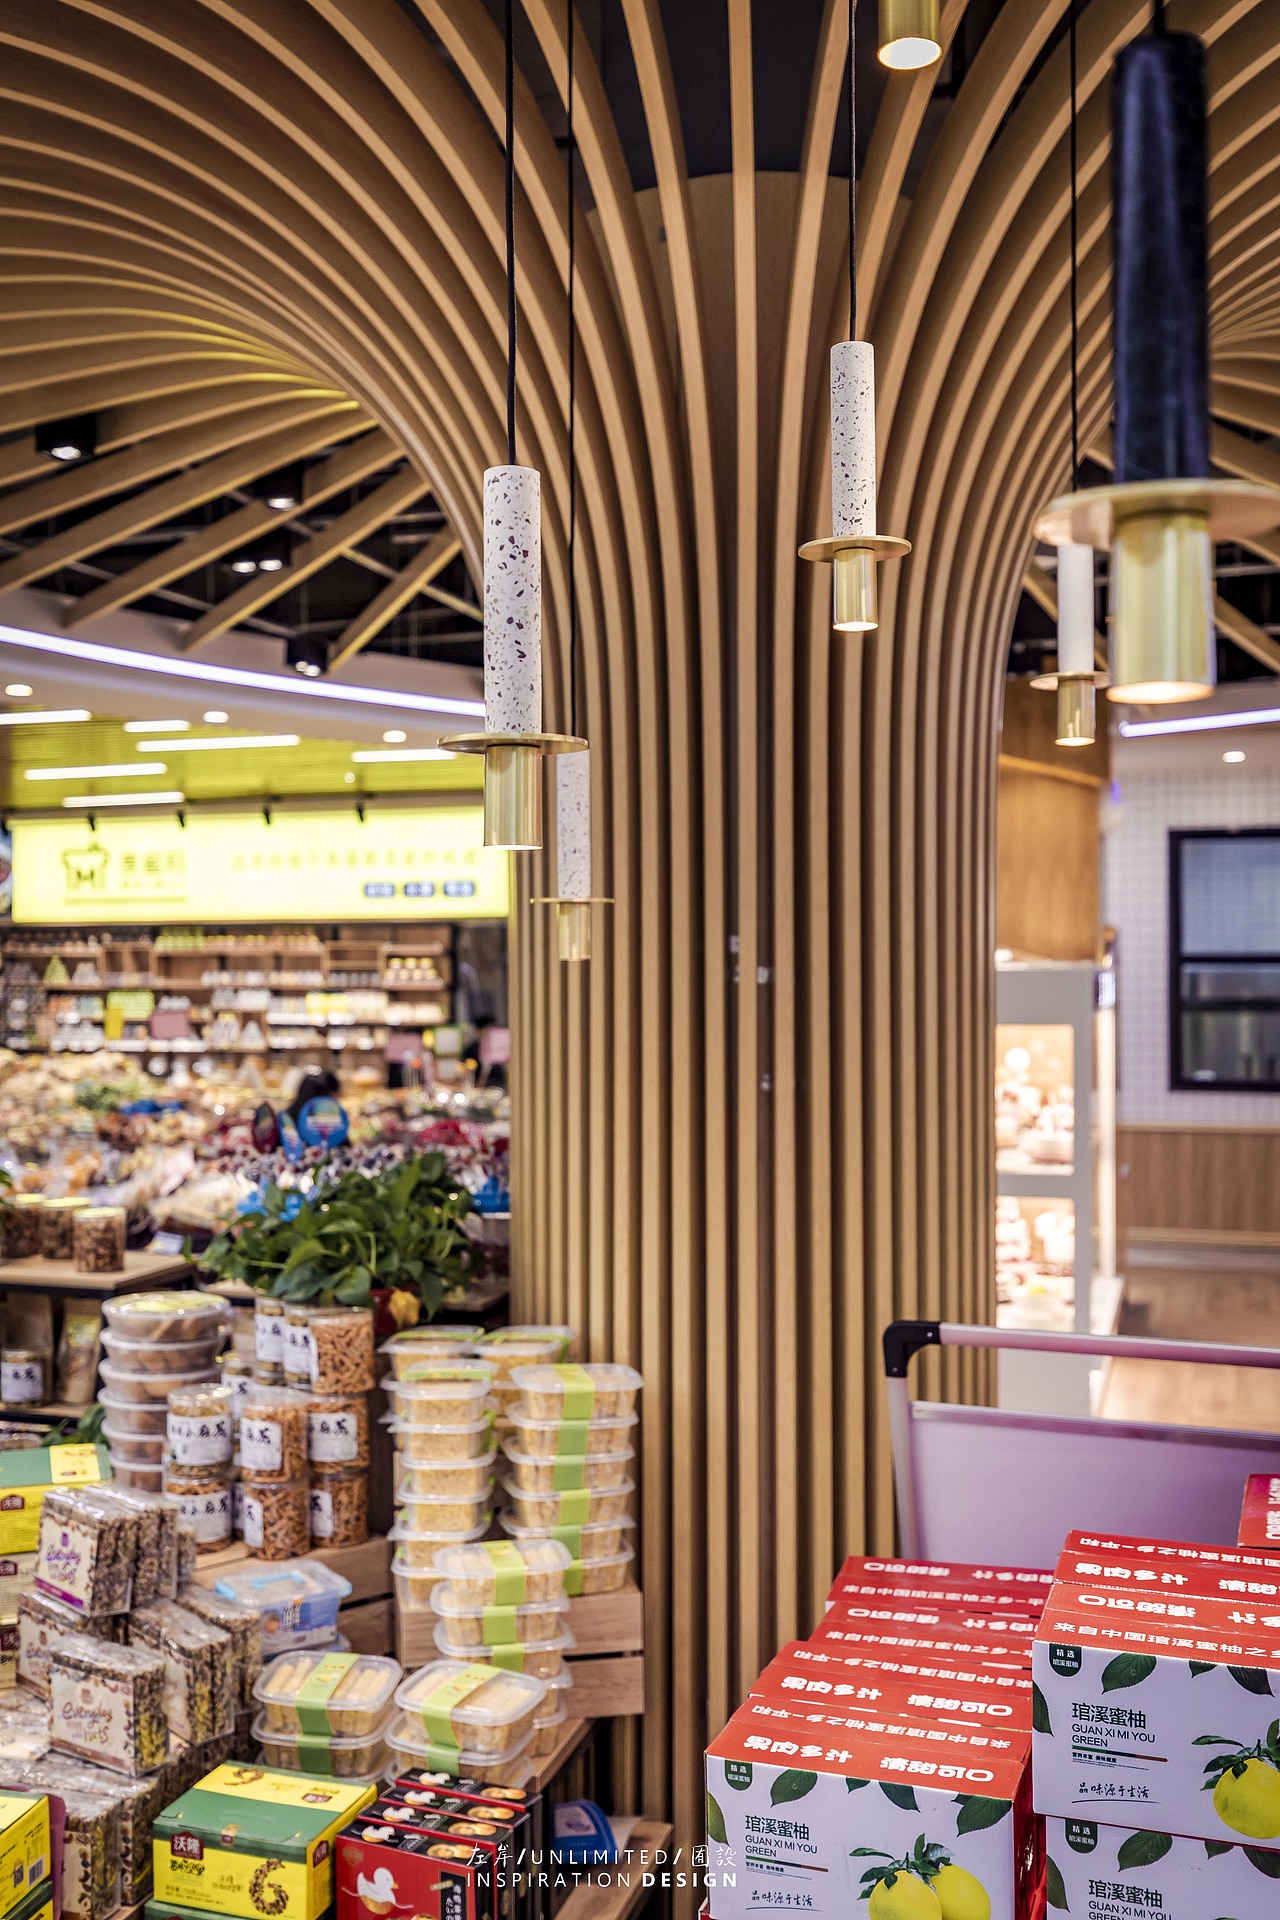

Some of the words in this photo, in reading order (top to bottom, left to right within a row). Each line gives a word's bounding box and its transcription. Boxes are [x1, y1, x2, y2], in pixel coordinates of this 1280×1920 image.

[1075, 1563, 1188, 1585] 果肉多汁
[1078, 1595, 1196, 1618] 清甜可口
[962, 1619, 1039, 1632] 肉多汁
[781, 1676, 882, 1701] 果肉多汁
[908, 1694, 1013, 1717] 清甜可口
[1072, 1703, 1146, 1729] 琯溪蜜柚
[1072, 1724, 1102, 1735] GUAN
[1105, 1728, 1115, 1737] XI
[1118, 1730, 1129, 1739] MI
[1131, 1731, 1155, 1743] YOU
[1072, 1735, 1108, 1747] GREEN
[743, 1735, 853, 1763] 果肉多汁
[880, 1757, 993, 1782] 清甜可口
[1079, 1782, 1149, 1799] 品味源于生活
[745, 1815, 810, 1841] 琯溪蜜柚
[745, 1835, 772, 1847] GUAN
[774, 1838, 783, 1848] XI
[784, 1841, 795, 1851] MI
[796, 1843, 818, 1854] YOU
[745, 1845, 777, 1857] GREEN
[752, 1890, 813, 1906] 品味源于生活
[1089, 1879, 1162, 1909] 琯溪蜜柚
[1089, 1900, 1119, 1913] GUAN
[1121, 1905, 1131, 1915] XI
[1134, 1908, 1145, 1918] MI
